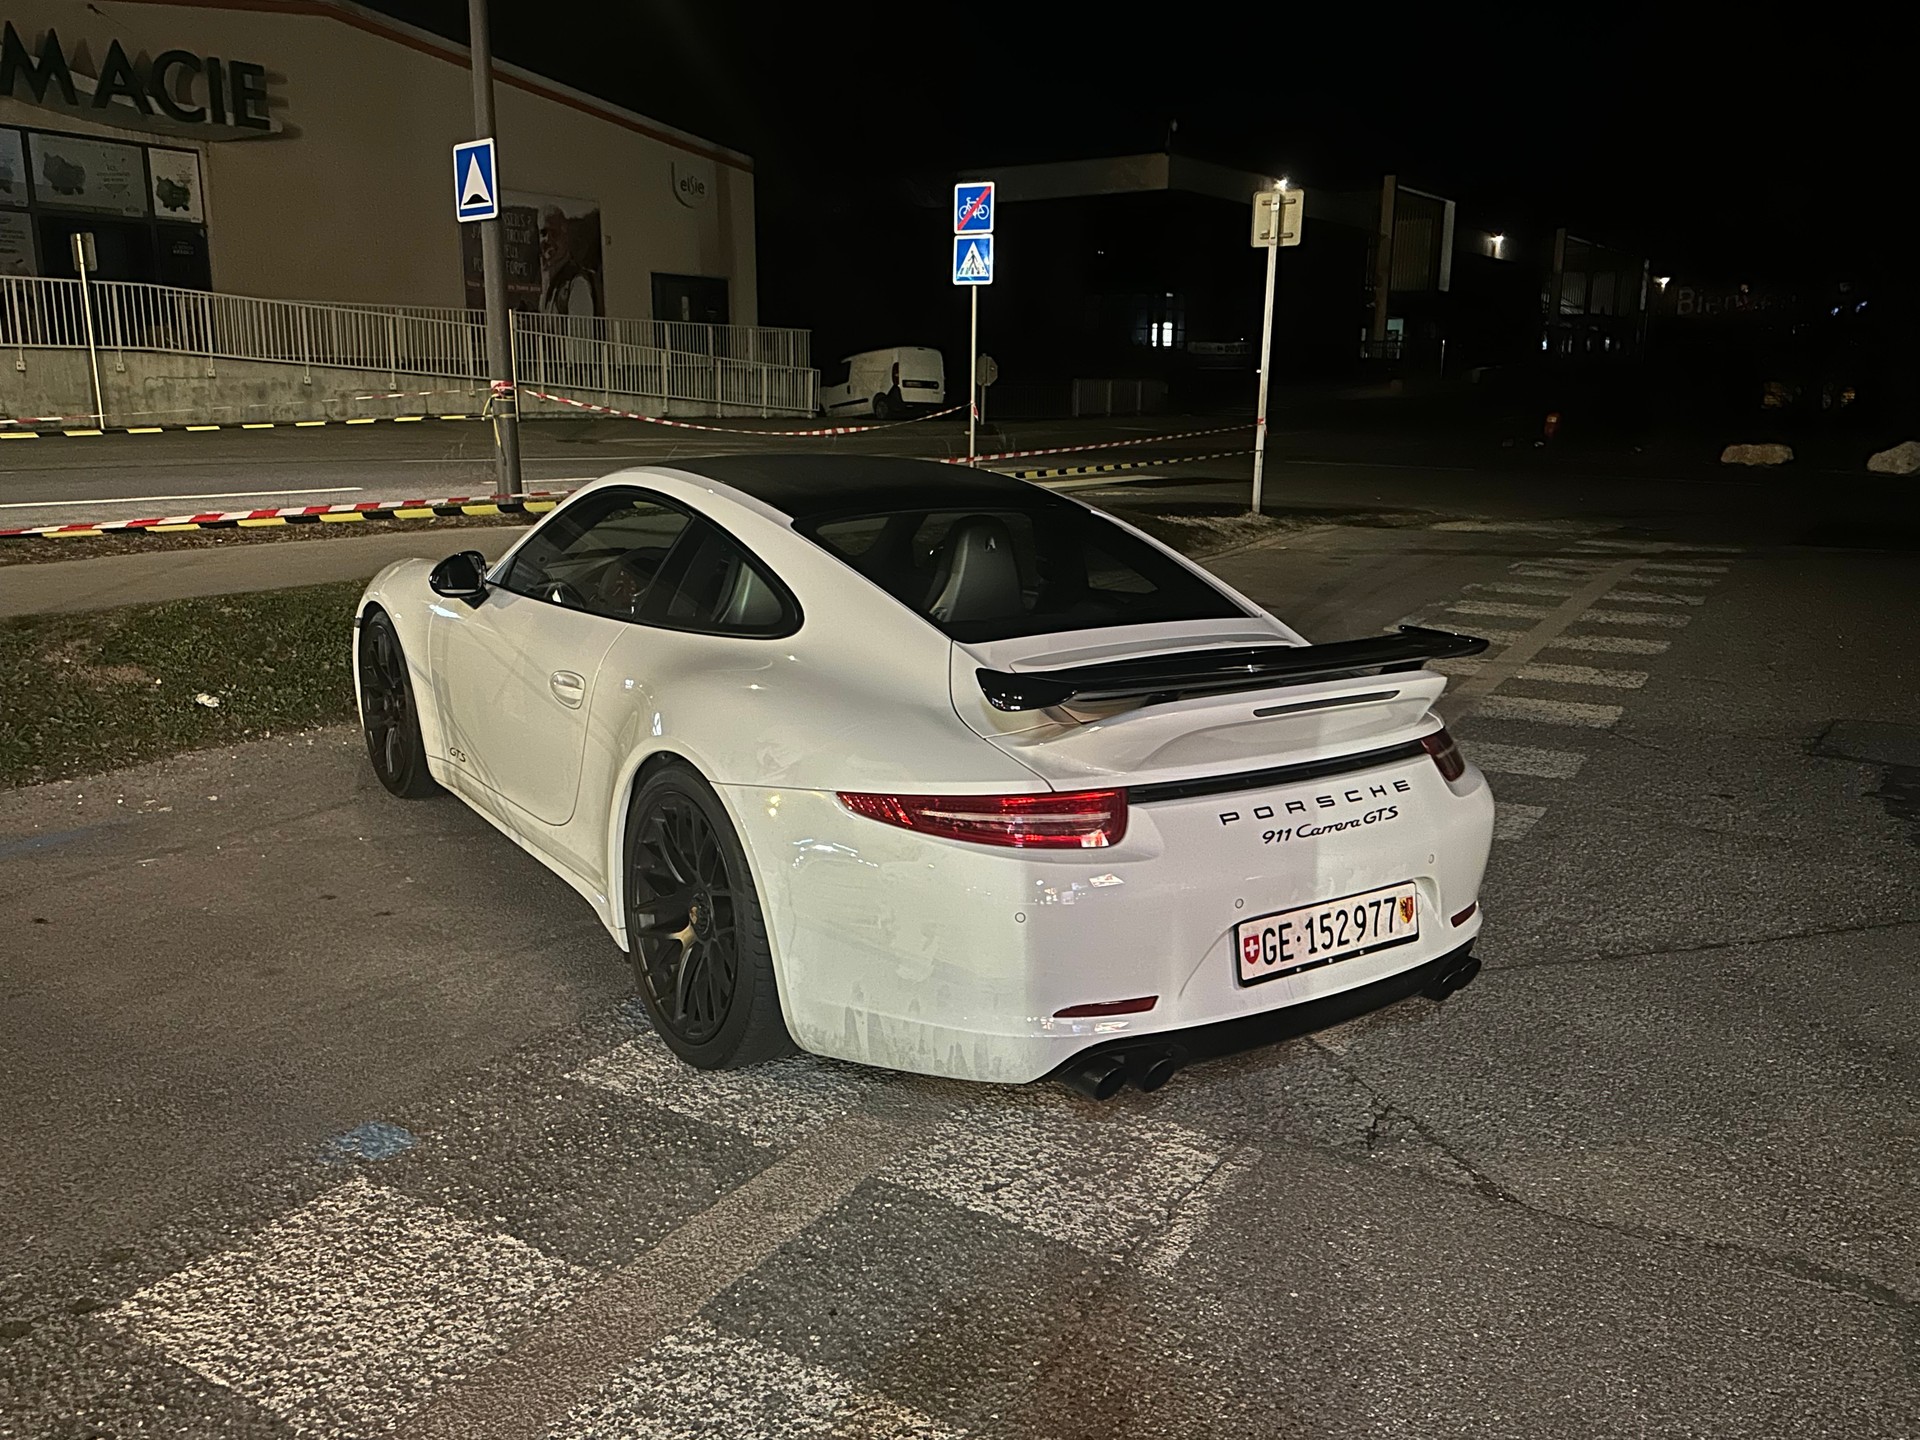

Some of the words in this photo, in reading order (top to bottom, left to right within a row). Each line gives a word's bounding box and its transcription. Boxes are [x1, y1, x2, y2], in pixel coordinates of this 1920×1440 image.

[449, 747, 466, 763] GTS
[1218, 779, 1411, 826] PORSCHE
[1261, 827, 1293, 844] 911
[1295, 818, 1361, 839] Carrera
[1362, 805, 1399, 824] GTS
